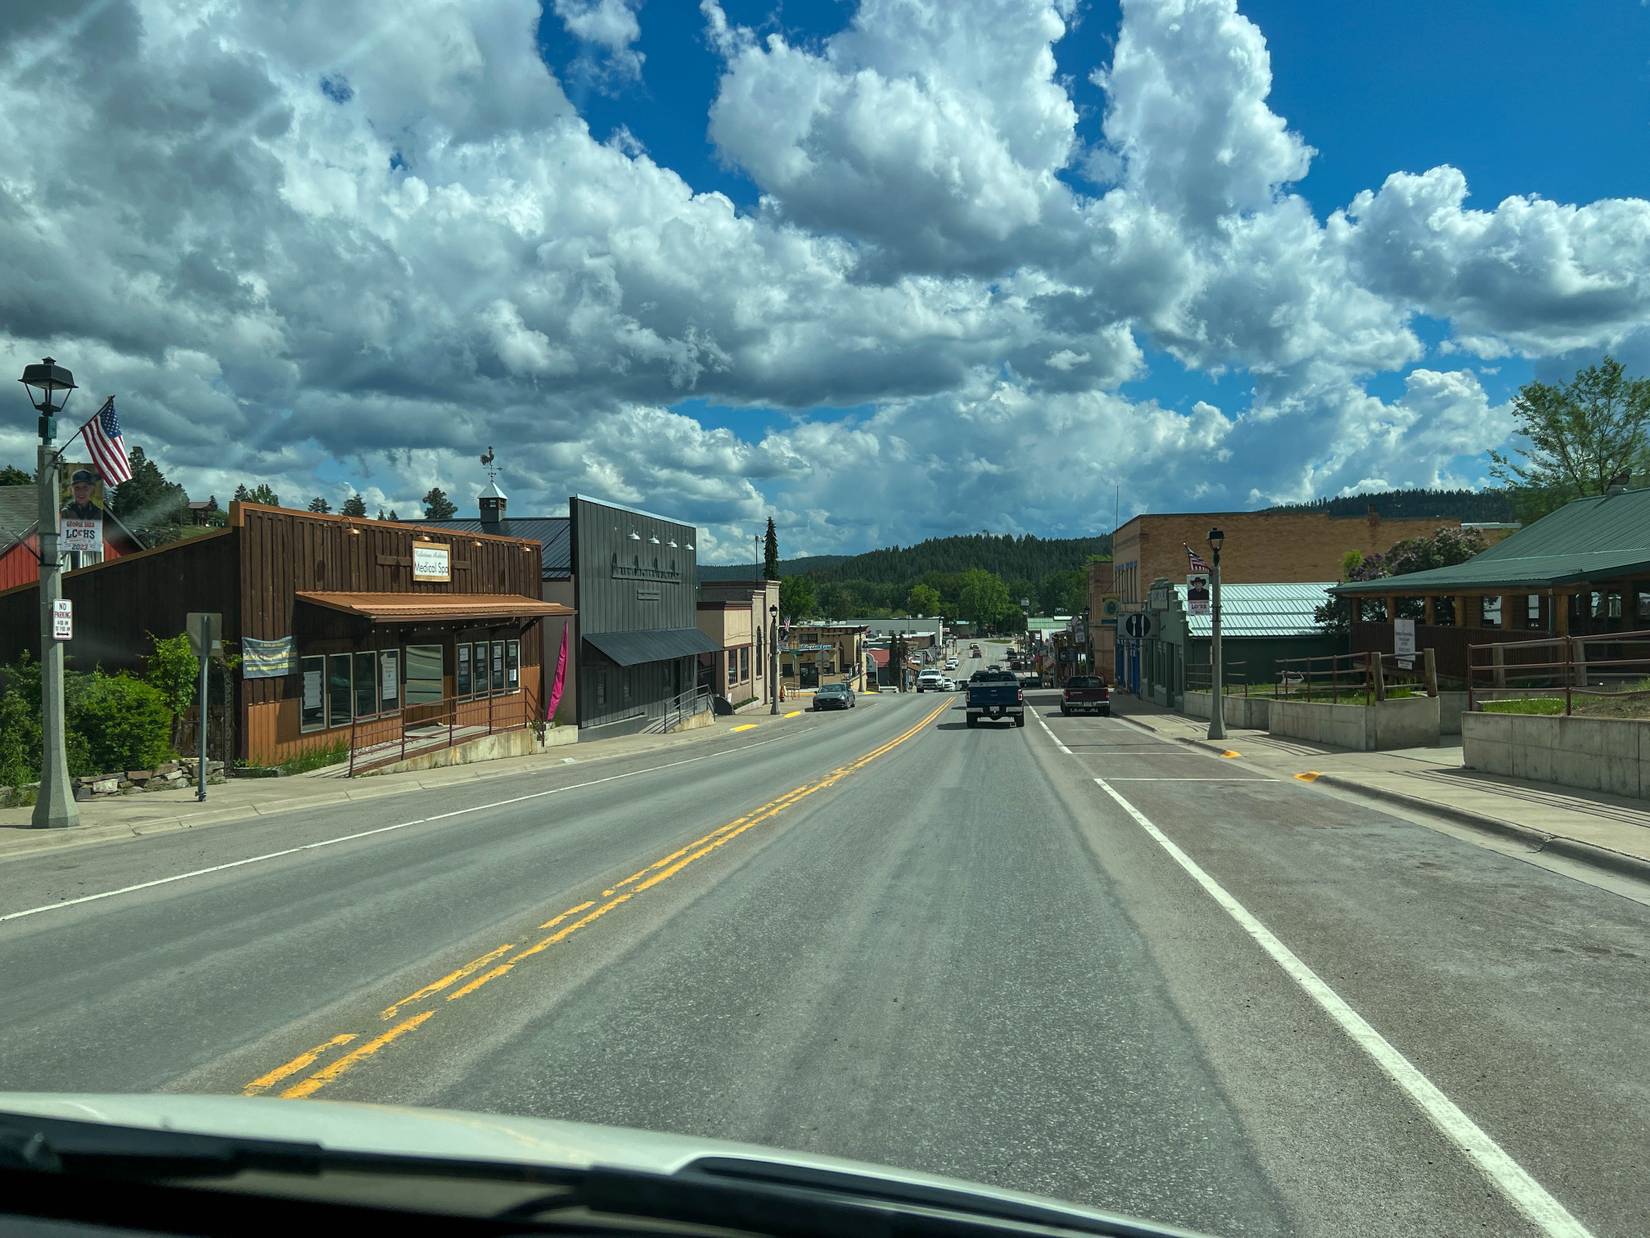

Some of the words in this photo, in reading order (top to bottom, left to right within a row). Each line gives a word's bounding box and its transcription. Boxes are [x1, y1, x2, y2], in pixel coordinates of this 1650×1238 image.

[415, 562, 437, 573] Medical
[438, 562, 449, 574] Spa
[58, 603, 66, 611] NO
